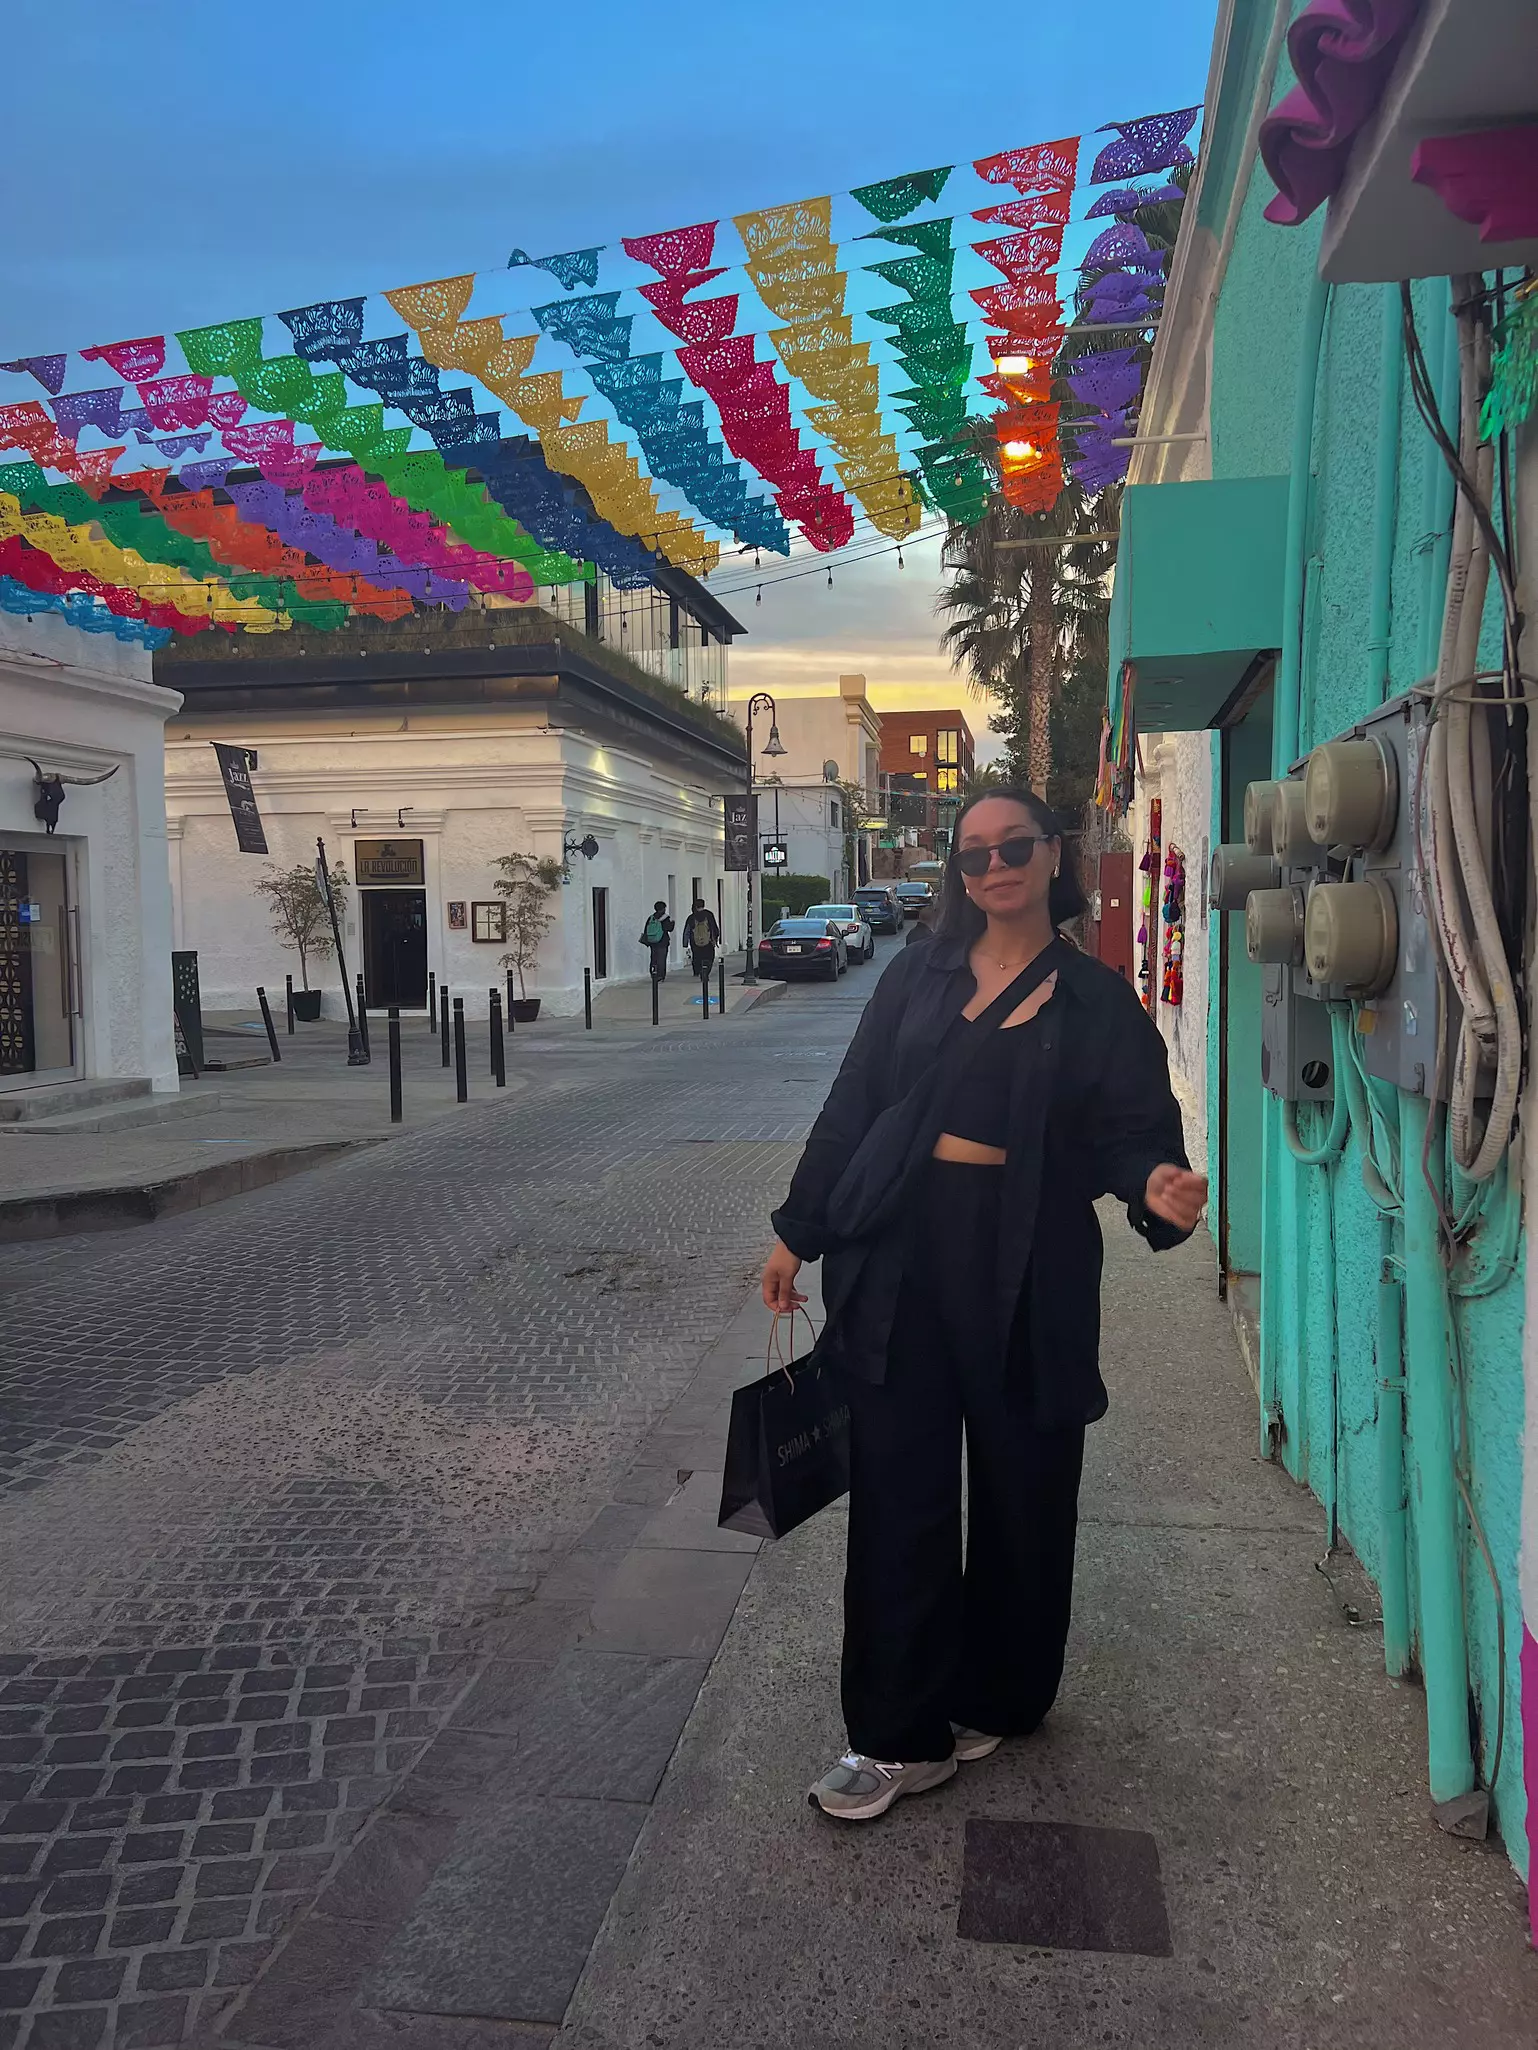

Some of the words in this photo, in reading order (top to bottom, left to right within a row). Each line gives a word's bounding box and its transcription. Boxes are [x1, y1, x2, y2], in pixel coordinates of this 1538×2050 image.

[228, 768, 249, 784] Jazz
[729, 811, 748, 824] Jaz
[360, 860, 370, 874] LA
[777, 1431, 811, 1467] SHIMA
